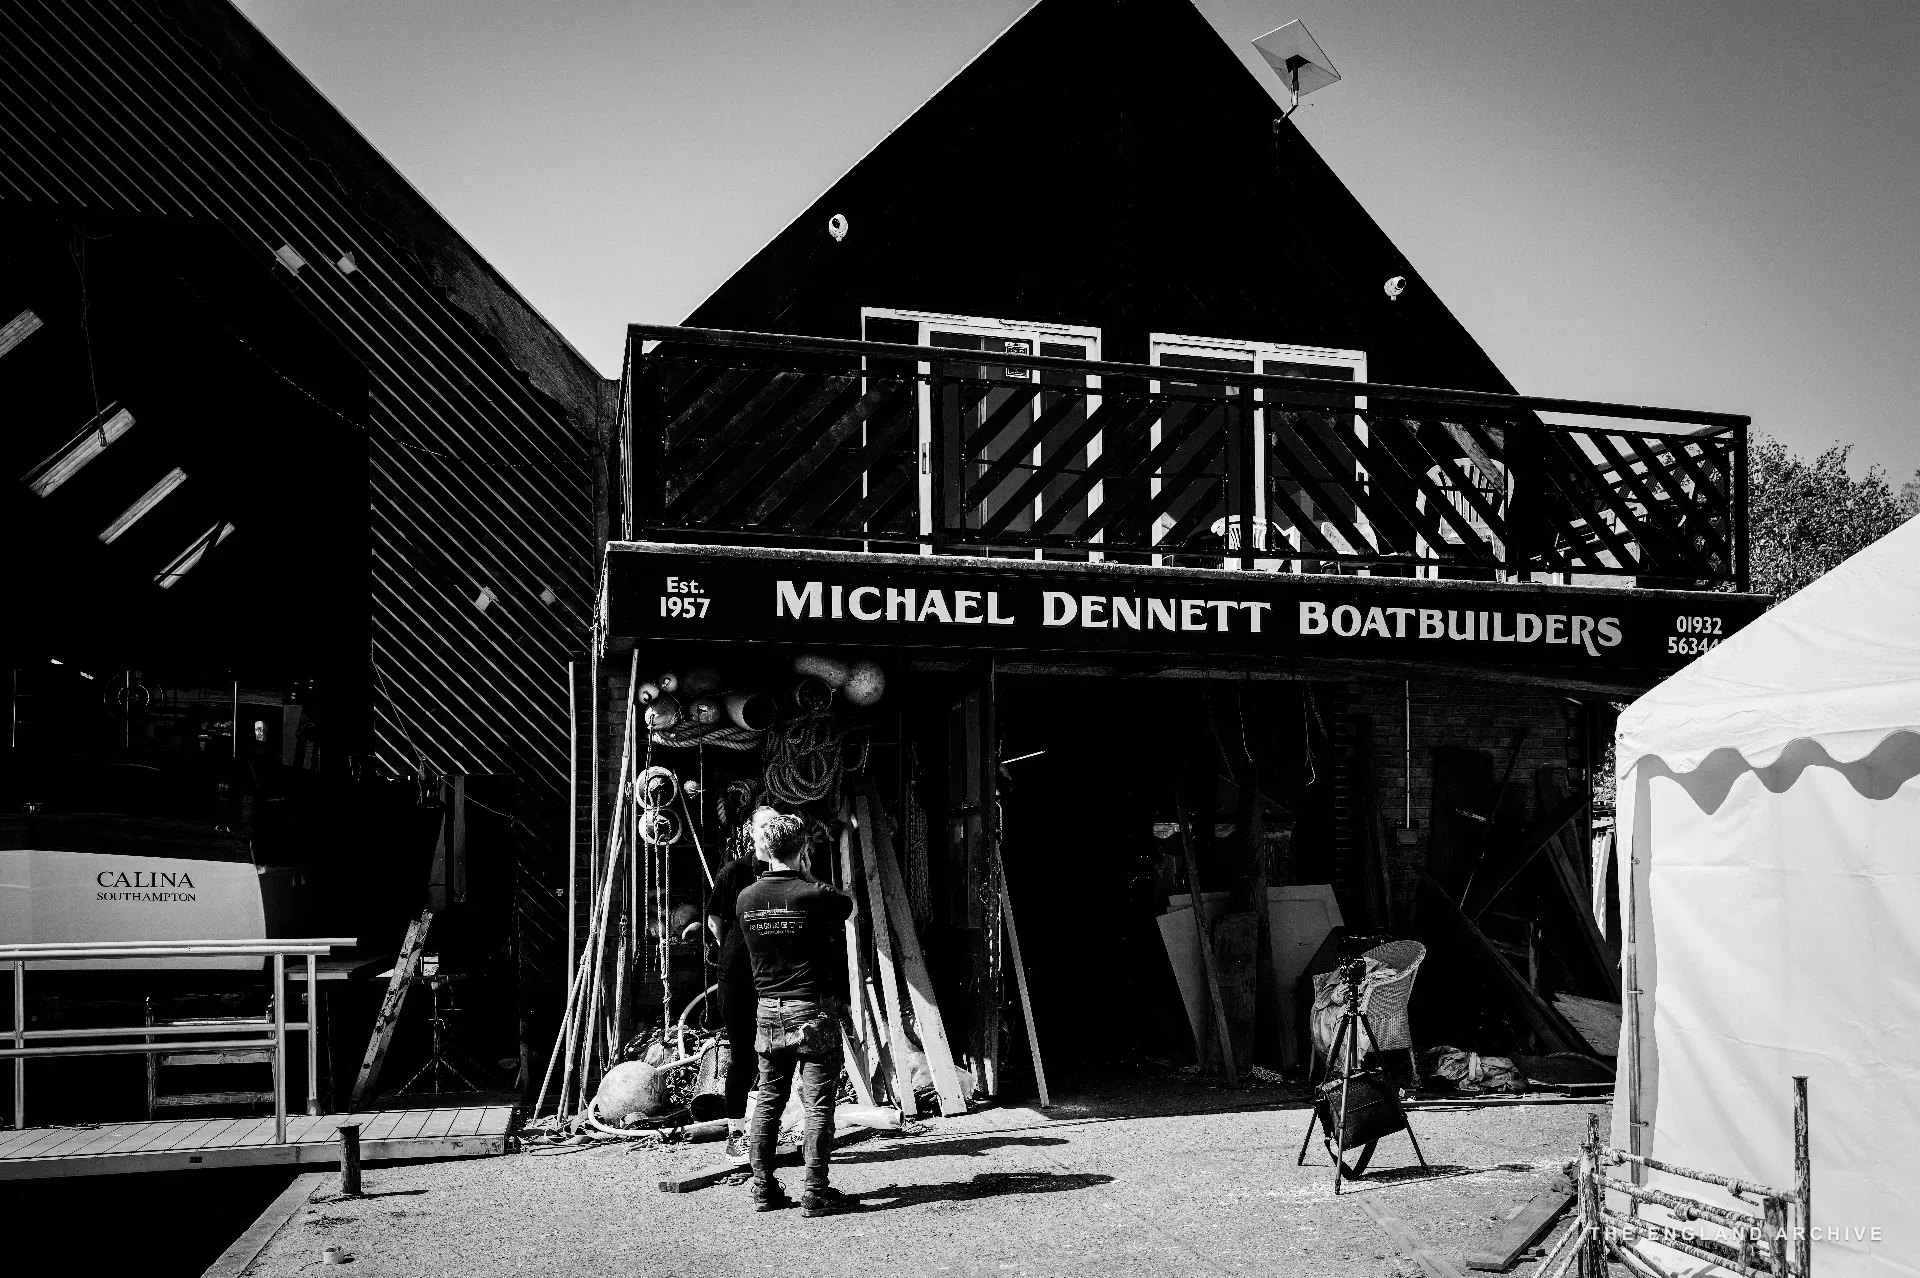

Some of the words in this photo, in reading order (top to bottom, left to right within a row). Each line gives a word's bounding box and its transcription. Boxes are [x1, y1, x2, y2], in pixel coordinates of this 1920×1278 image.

[667, 577, 705, 594] Est.
[660, 597, 711, 619] 1957
[776, 580, 1015, 626] MICHAEL
[1042, 590, 1272, 634] DENNETT
[1299, 601, 1623, 658] BOATBUILDERS
[1676, 615, 1723, 635] 01932
[1667, 636, 1727, 655] 56344
[96, 871, 196, 889] CALINA
[96, 892, 196, 902] SOUTHAMPTON
